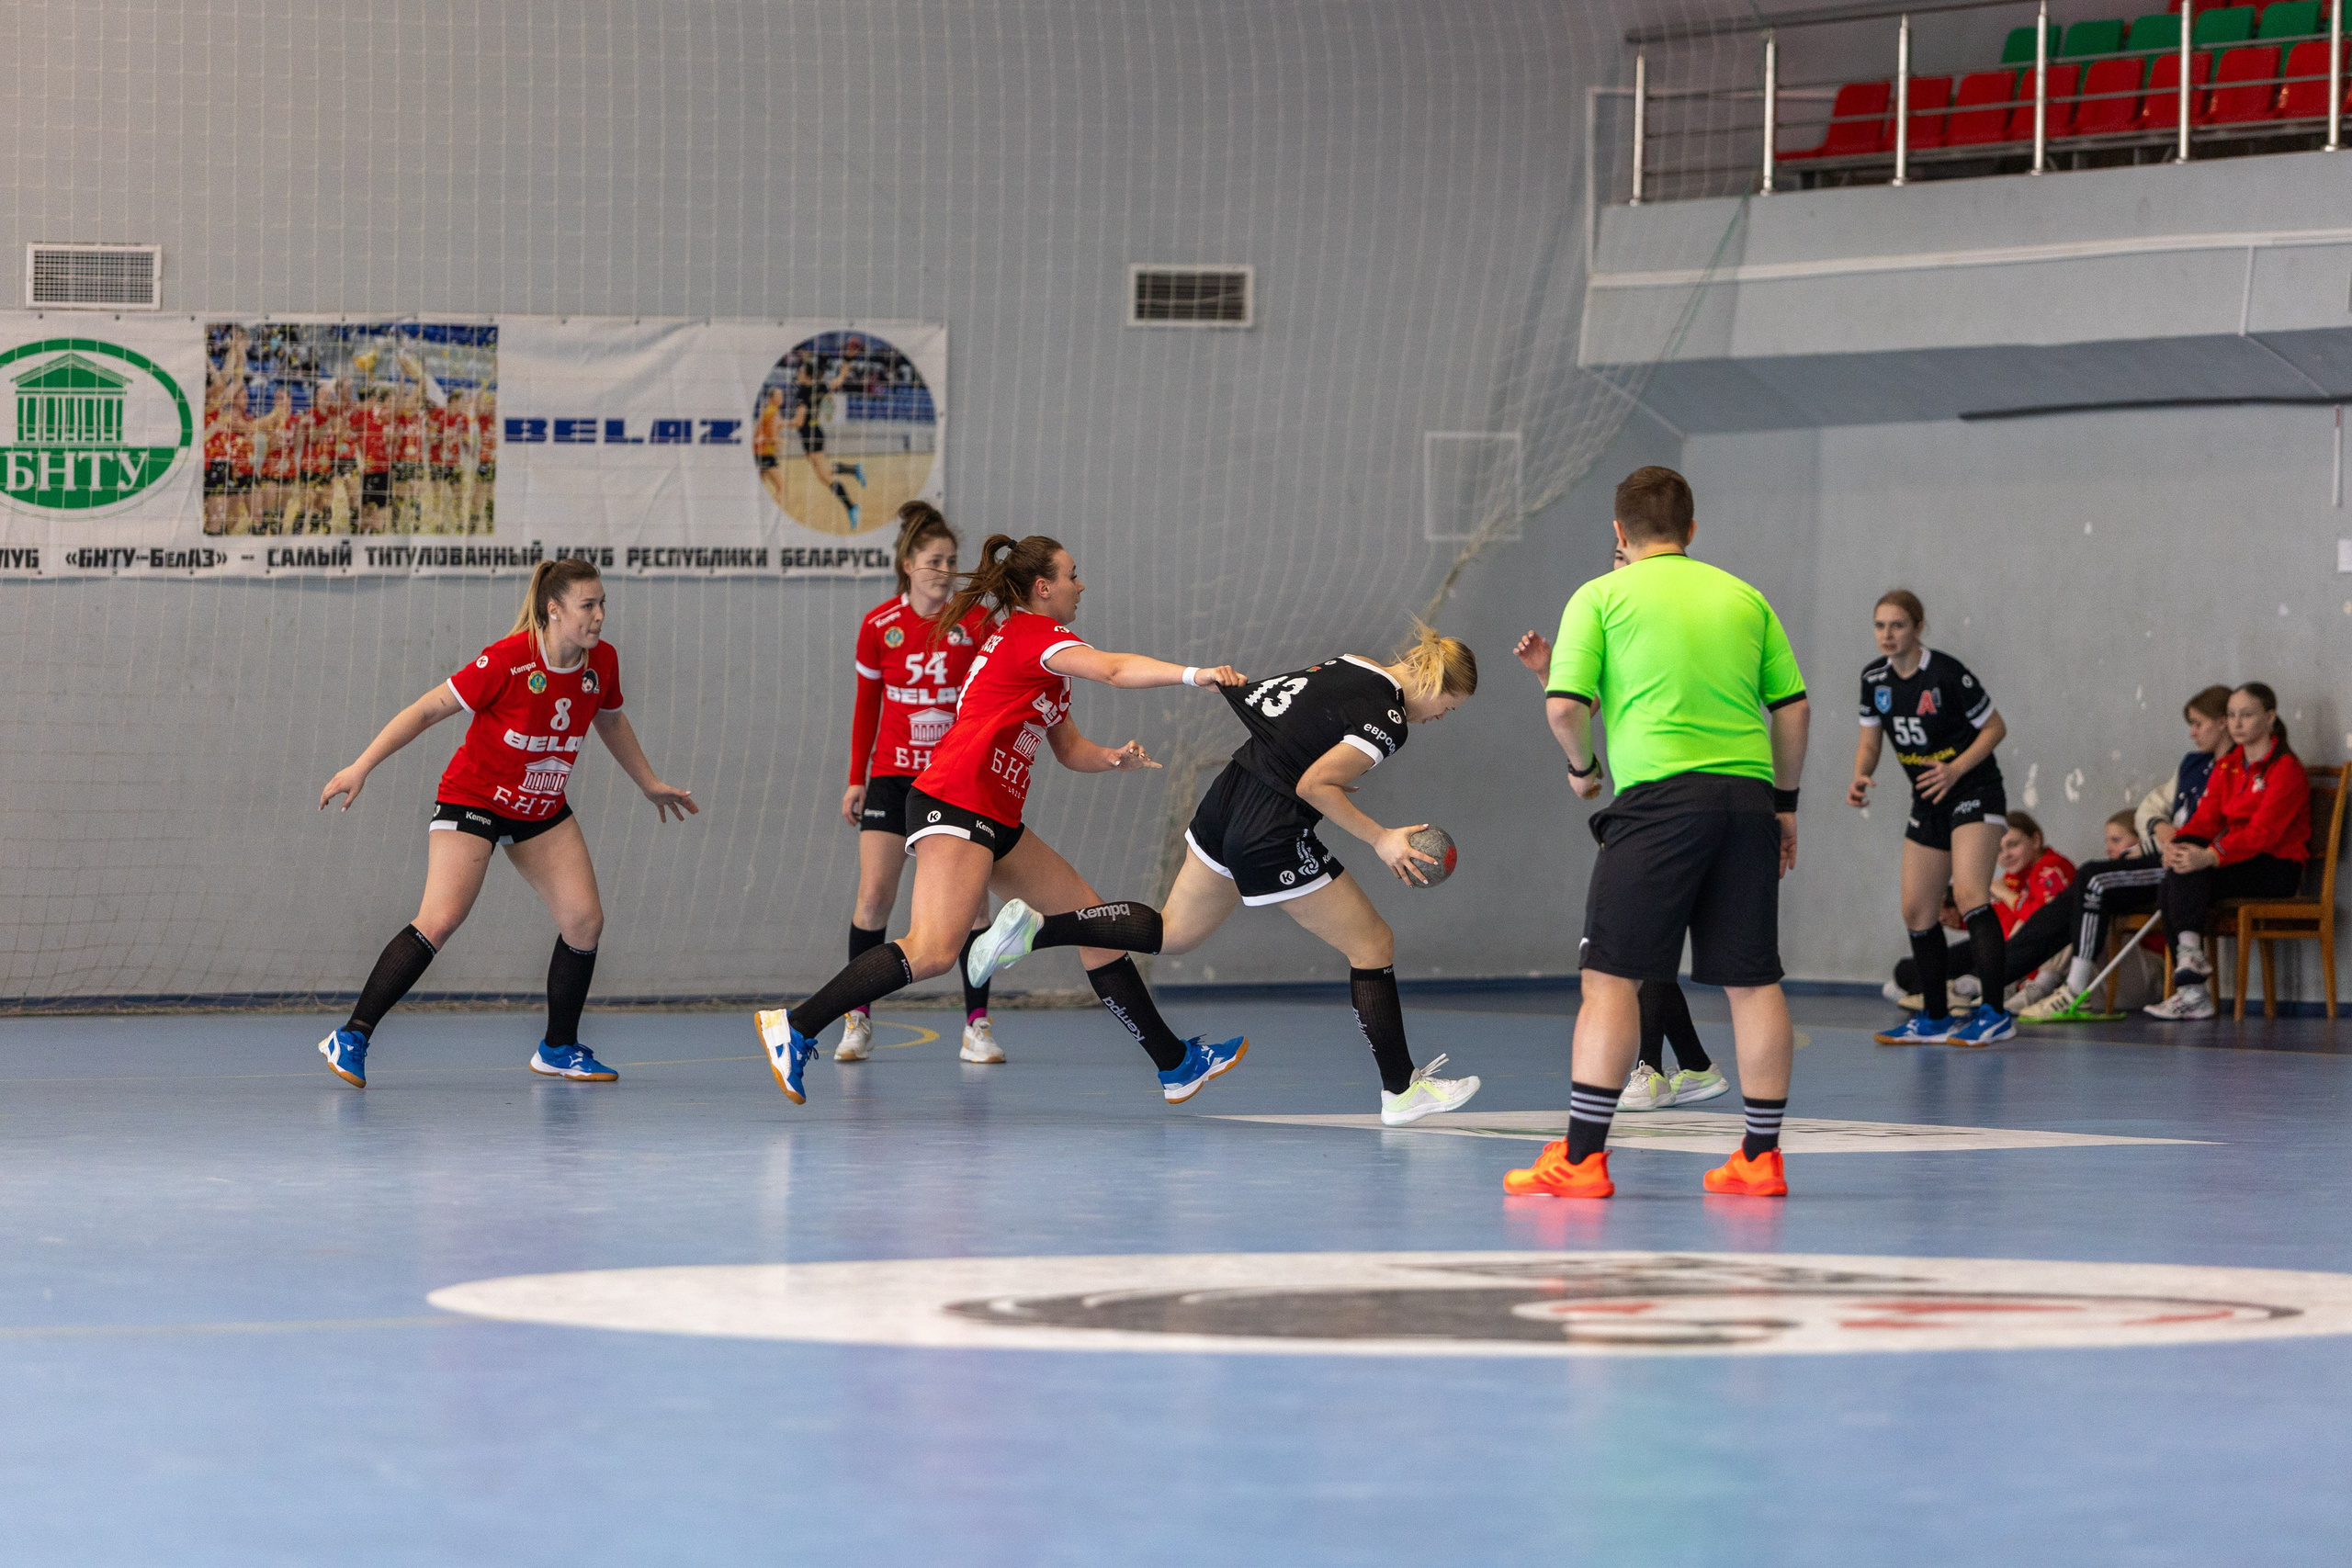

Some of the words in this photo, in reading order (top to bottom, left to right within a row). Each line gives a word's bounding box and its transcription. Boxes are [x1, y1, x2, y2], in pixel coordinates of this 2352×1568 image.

[504, 419, 742, 444] BELAZ
[5, 451, 149, 491] БНТУ
[266, 539, 352, 567] САМЫЙ
[365, 540, 543, 567] ТИТУЛОВАННЫЙ
[627, 547, 768, 568] РЕСПУБЛИКИ
[781, 547, 890, 568] БЕЛАРУСЬ
[510, 661, 537, 676] Kempa
[905, 651, 948, 685] 54
[1245, 675, 1308, 717] 13
[549, 697, 571, 731] 8
[1893, 716, 1928, 746] 55
[493, 785, 557, 816] БНТ
[466, 811, 492, 826] Kempa
[1076, 903, 1130, 921] Kempa
[1102, 996, 1145, 1042] Kempa
